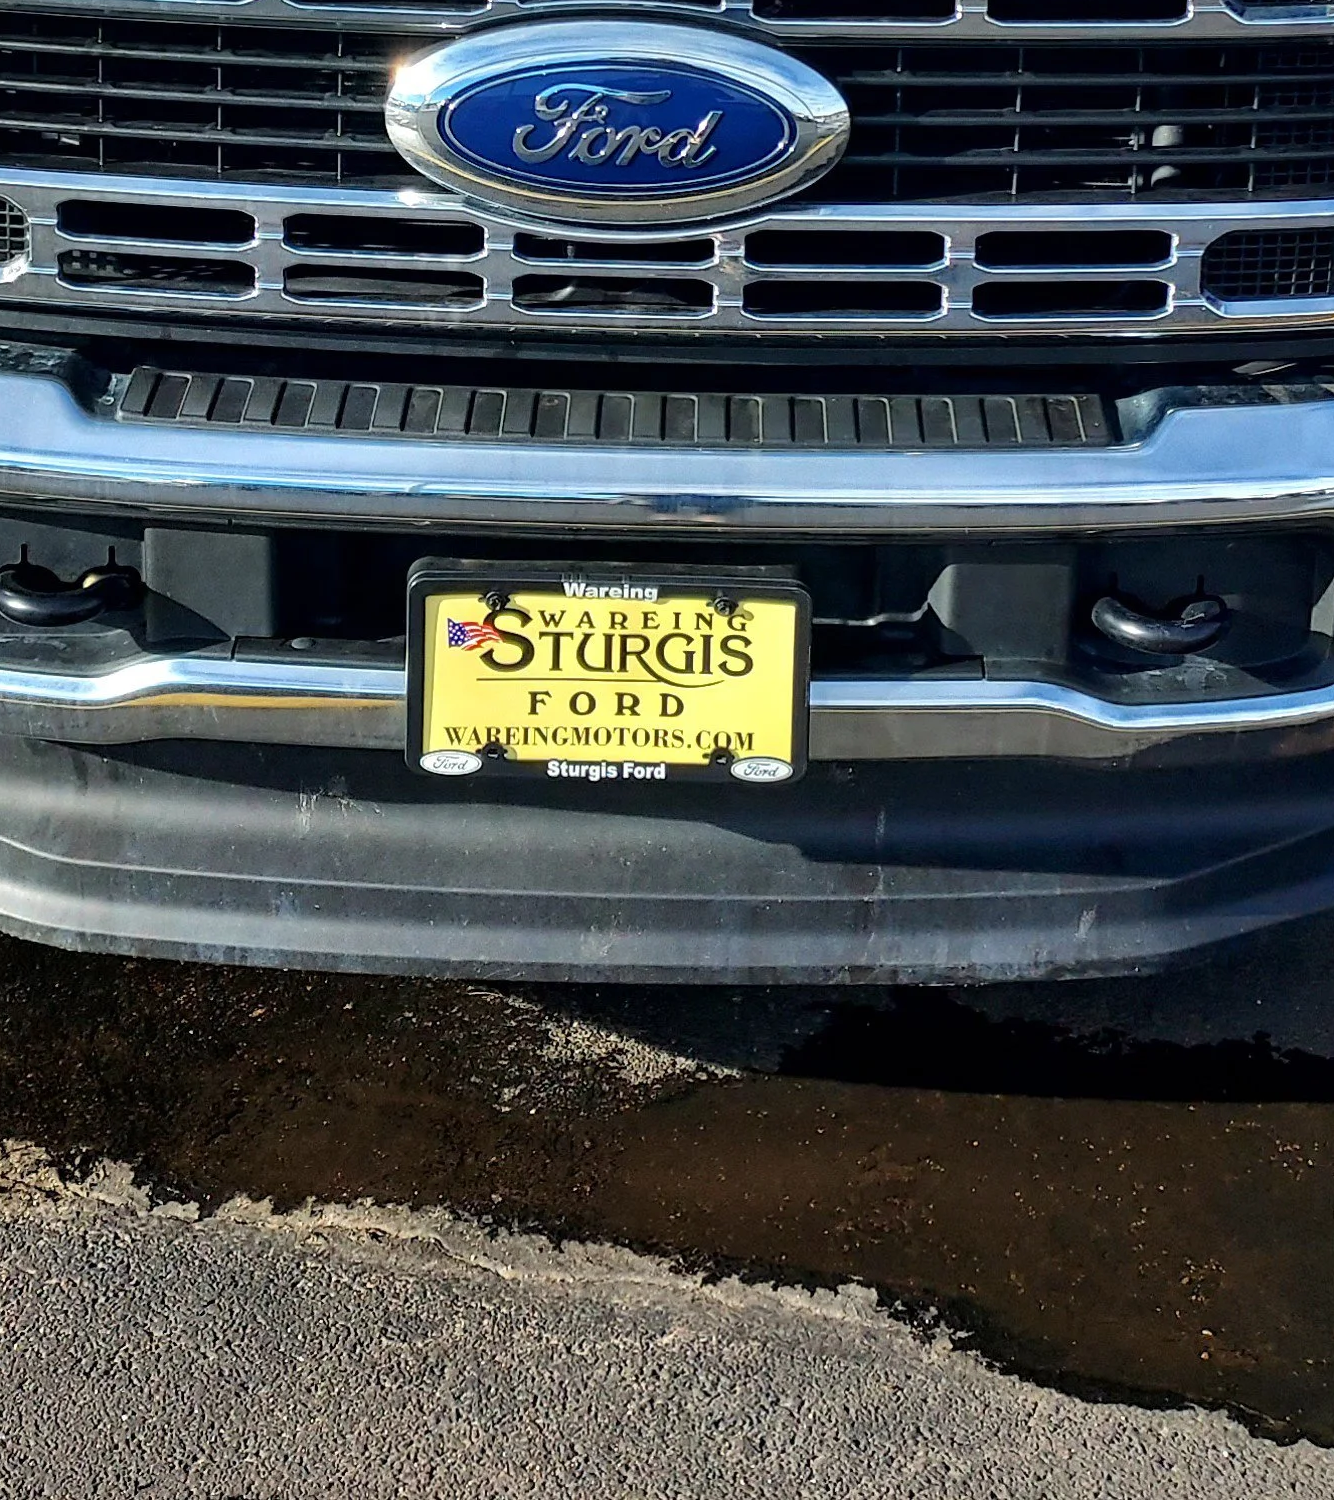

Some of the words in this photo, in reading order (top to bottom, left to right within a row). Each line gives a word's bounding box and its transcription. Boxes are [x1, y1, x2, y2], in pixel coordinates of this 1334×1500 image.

[512, 81, 724, 169] Ford
[562, 581, 659, 603] Wareing
[538, 609, 748, 632] WAREING
[479, 606, 755, 688] STURGIS
[527, 690, 685, 718] FORD
[442, 725, 756, 752] WAREINGMOTORS.COM
[432, 755, 469, 771] Ford
[546, 760, 618, 781] Sturgis
[623, 762, 666, 781] Ford
[743, 762, 779, 778] Ford
